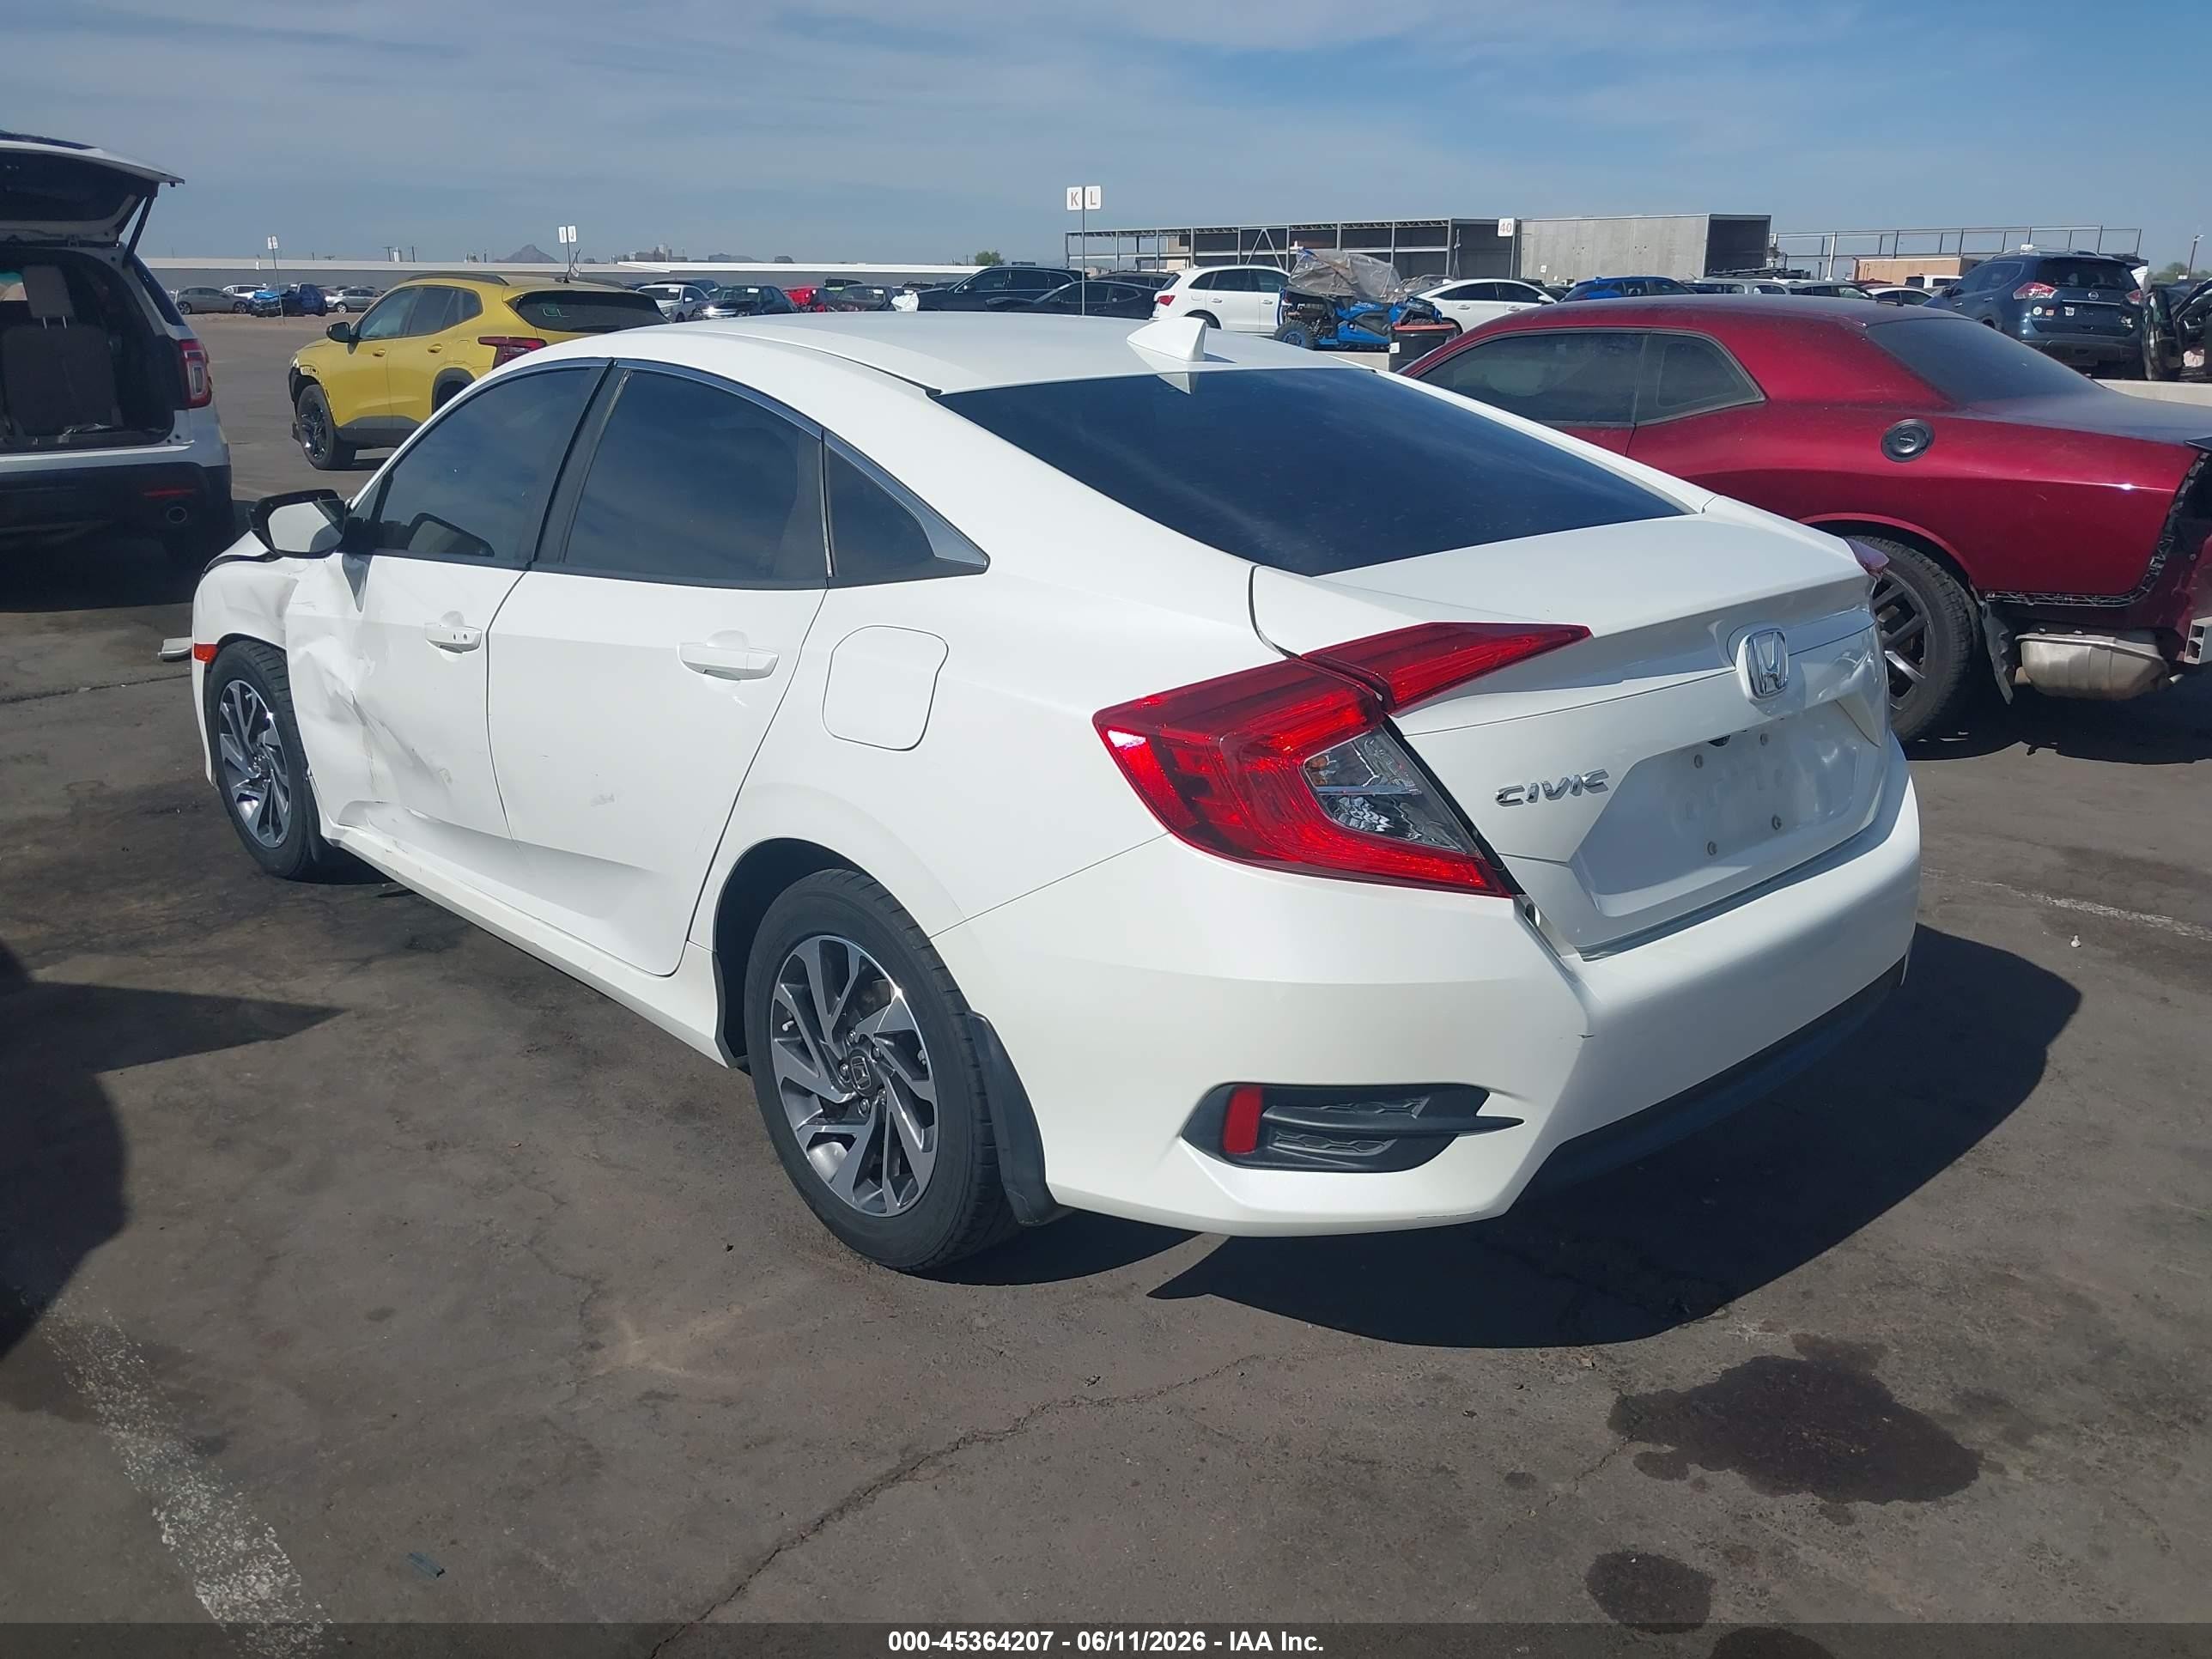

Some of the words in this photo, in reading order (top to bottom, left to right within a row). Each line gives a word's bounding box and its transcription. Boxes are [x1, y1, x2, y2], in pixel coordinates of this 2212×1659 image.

[1070, 191, 1079, 207] K
[1090, 191, 1097, 206] L
[1499, 222, 1512, 234] 40
[1495, 769, 1609, 807] CIVIC
